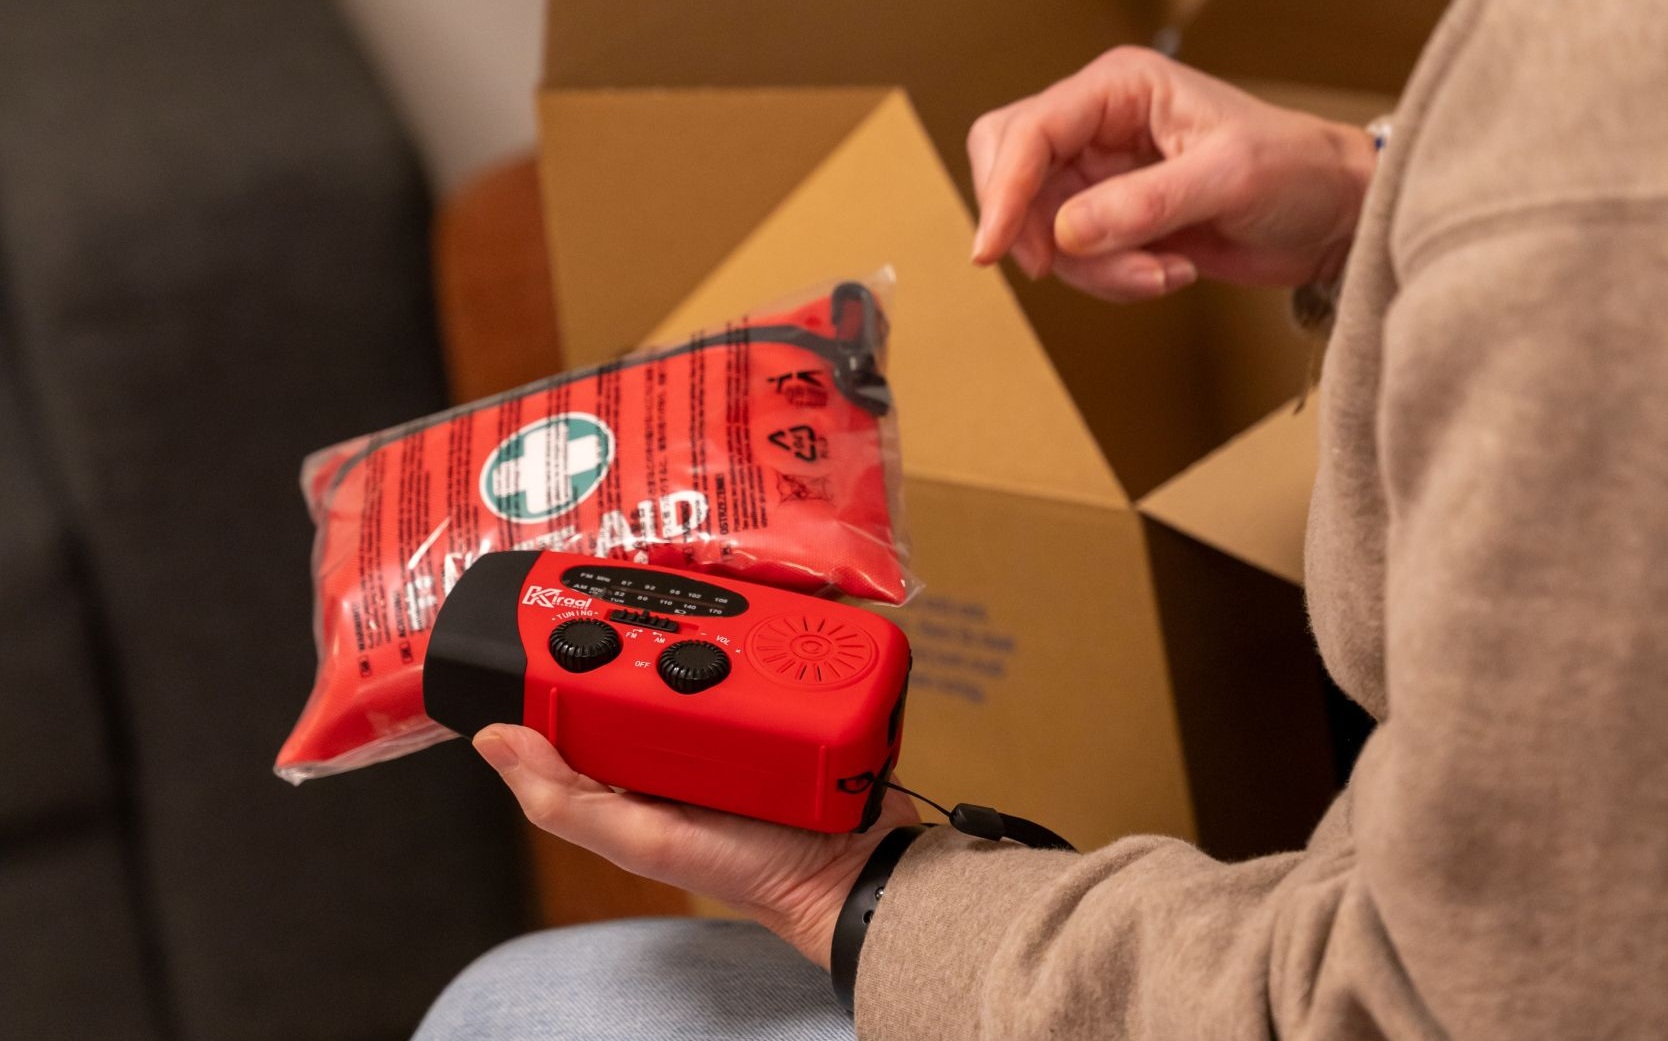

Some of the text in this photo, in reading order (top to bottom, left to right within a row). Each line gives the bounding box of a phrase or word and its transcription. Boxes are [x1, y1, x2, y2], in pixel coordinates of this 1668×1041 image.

[594, 490, 709, 558] AID
[580, 572, 593, 580] FM
[522, 585, 593, 608] Kiraal
[556, 610, 593, 619] TUNING
[716, 635, 731, 646] VOL
